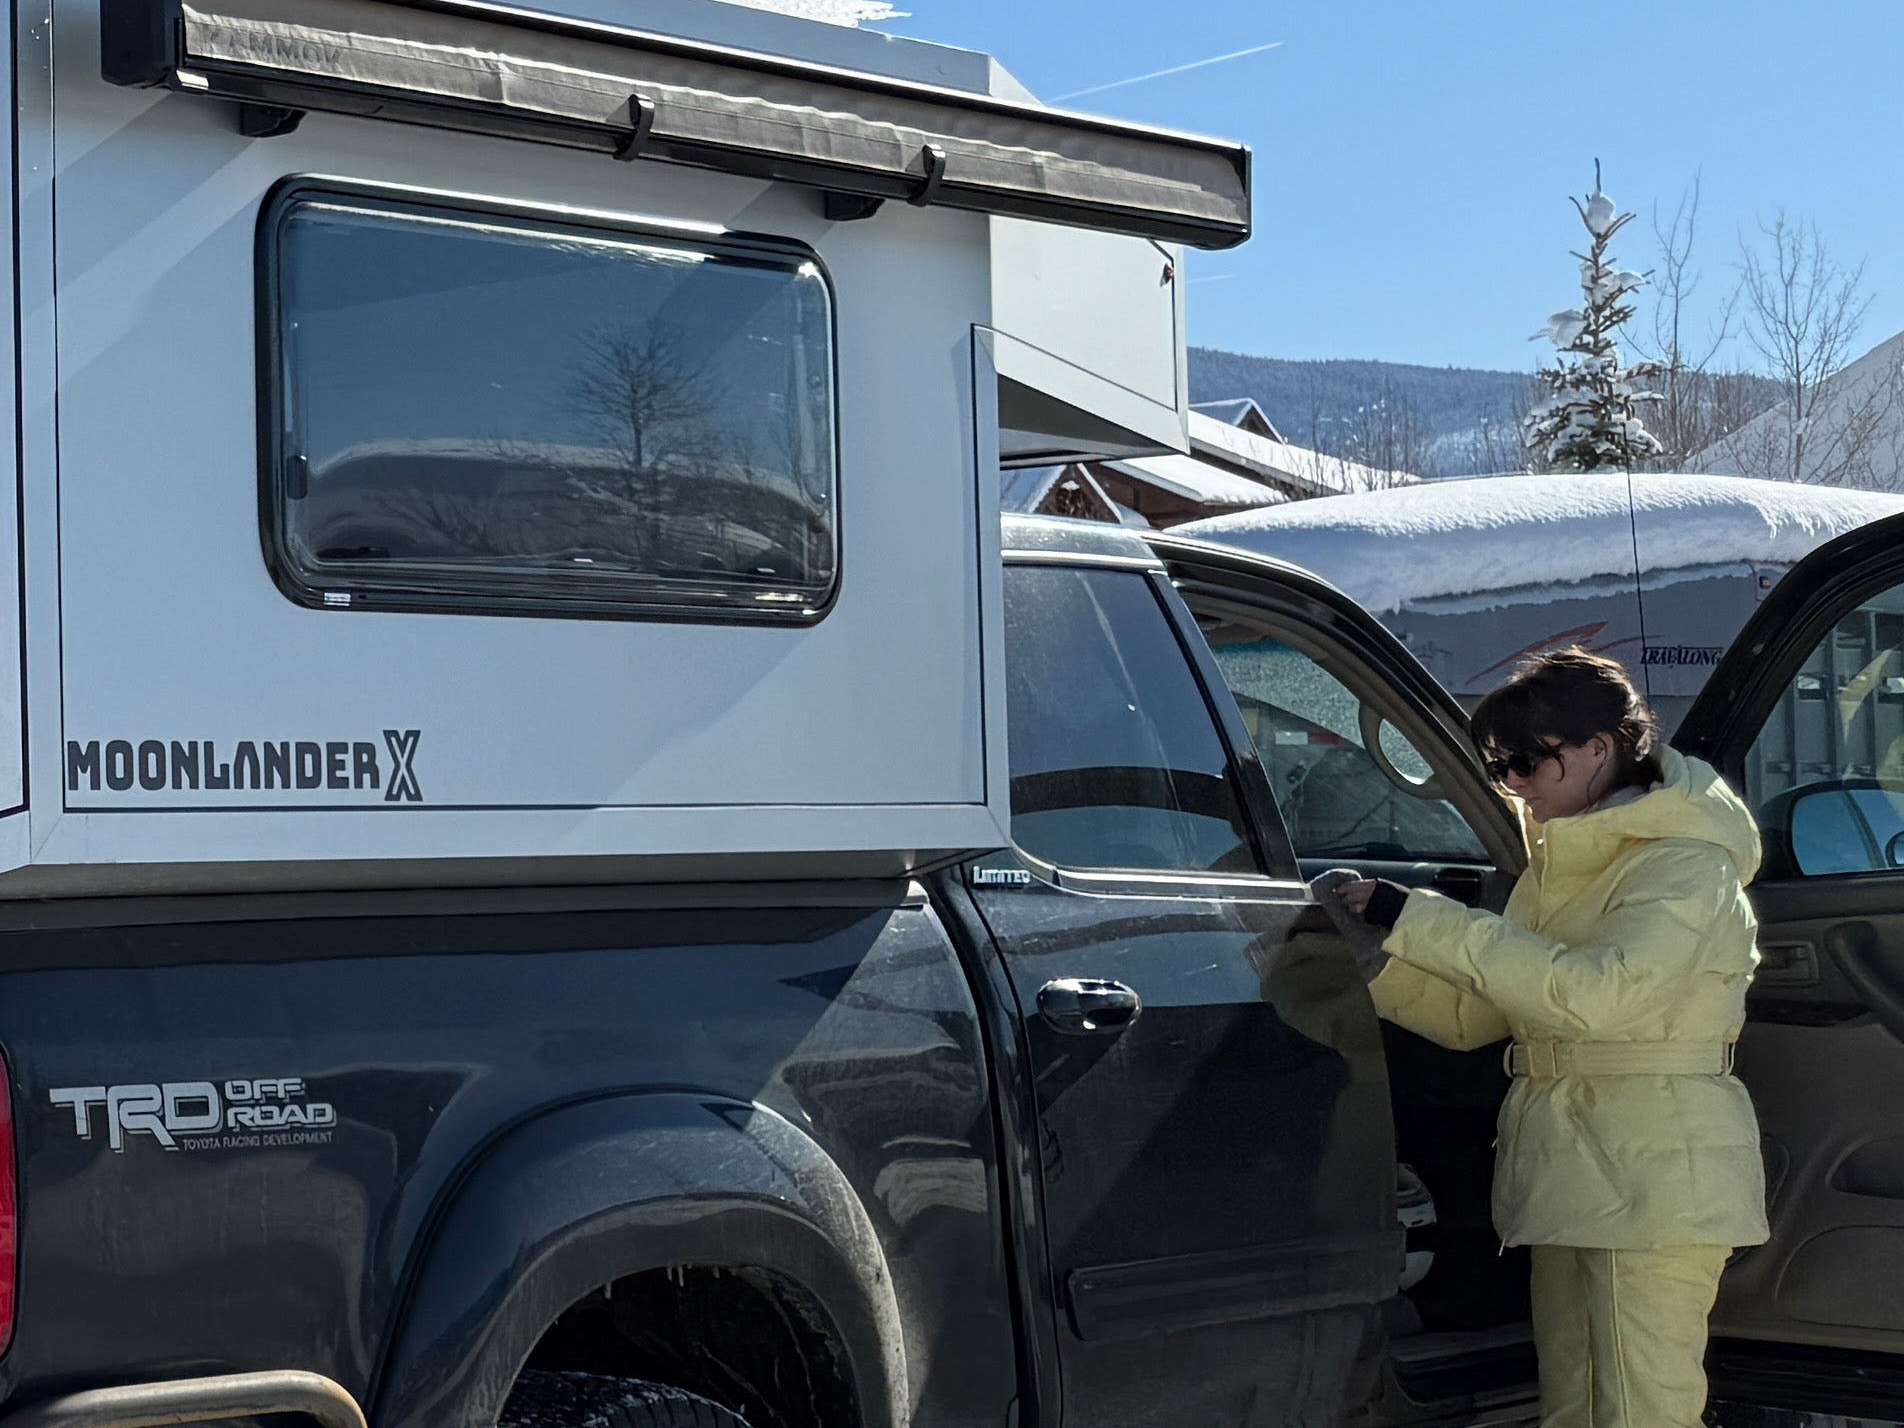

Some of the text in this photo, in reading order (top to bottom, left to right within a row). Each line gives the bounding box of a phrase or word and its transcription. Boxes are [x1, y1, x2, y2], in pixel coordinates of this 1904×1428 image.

[224, 1077, 306, 1104] OFF
[49, 1081, 223, 1154] TRD
[226, 1102, 337, 1132] ROAD
[182, 1131, 333, 1151] TOYOTA RACING DEVELOPMENT
